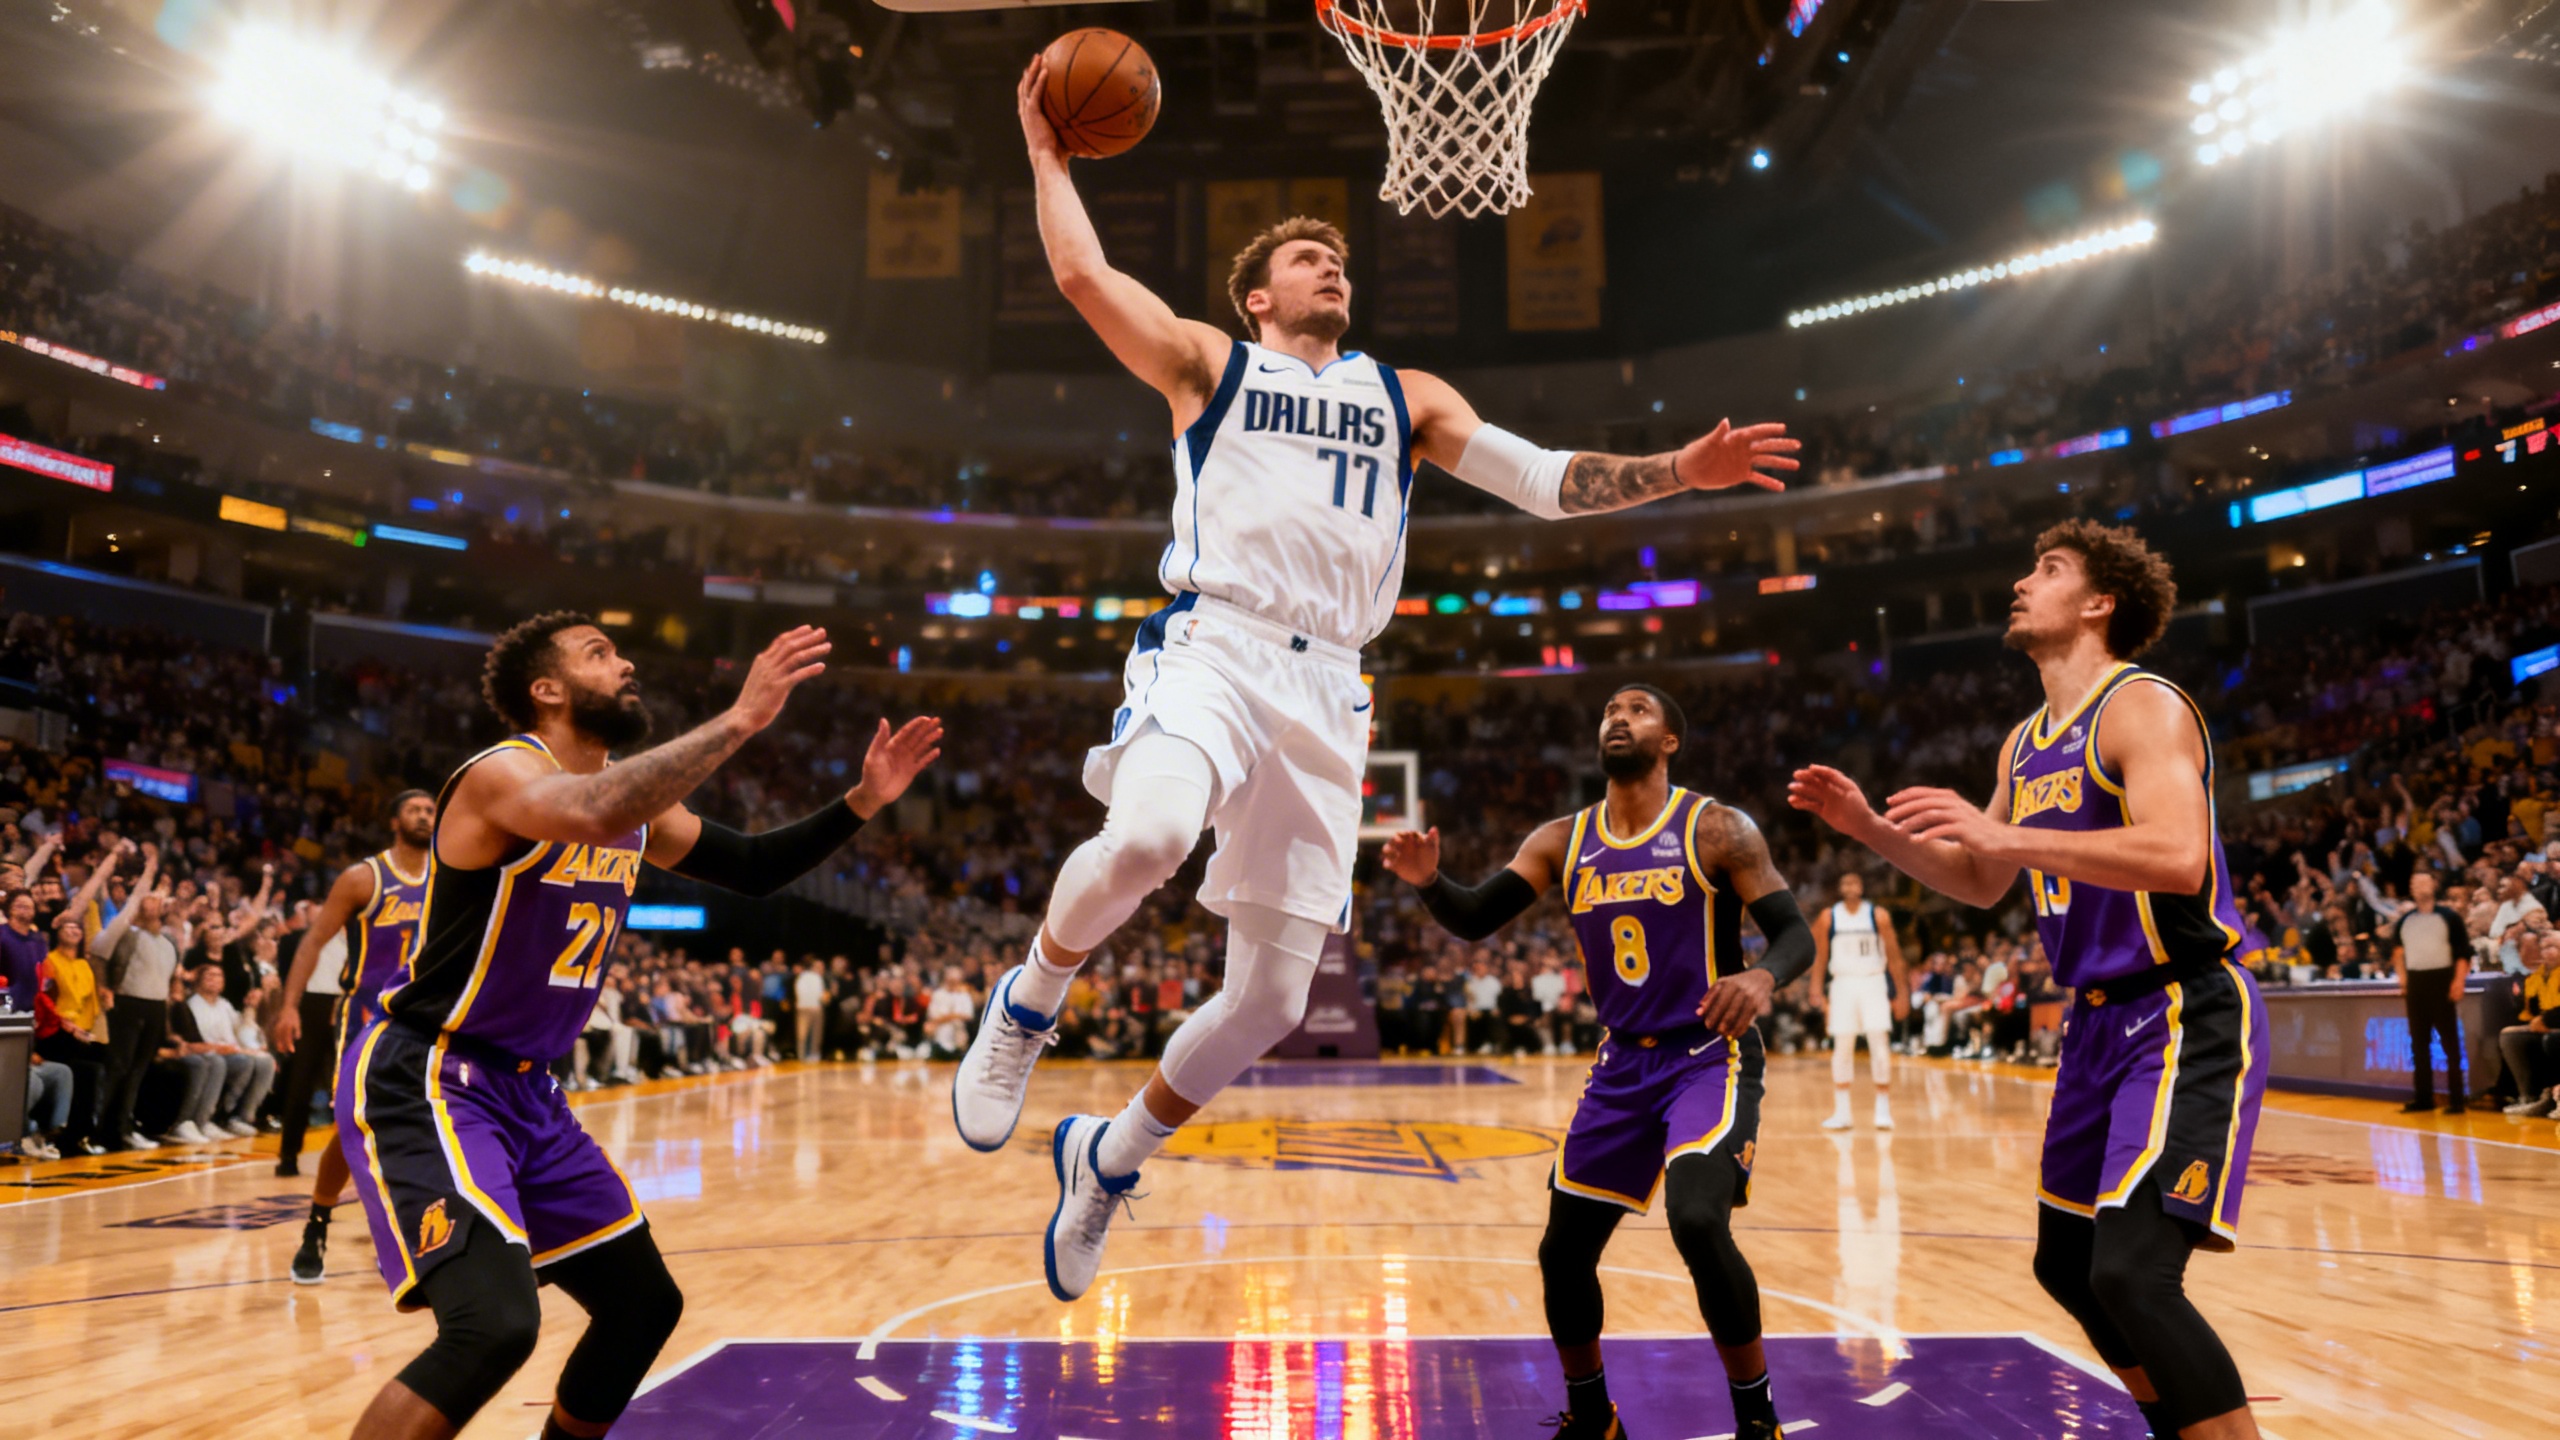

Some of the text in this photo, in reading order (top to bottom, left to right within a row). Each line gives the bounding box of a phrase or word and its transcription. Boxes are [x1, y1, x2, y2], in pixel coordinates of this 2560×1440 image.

[1243, 388, 1385, 448] DALLAS
[1316, 447, 1380, 520] 77
[1571, 865, 1686, 915] LAKERS
[1610, 914, 1651, 988] 8
